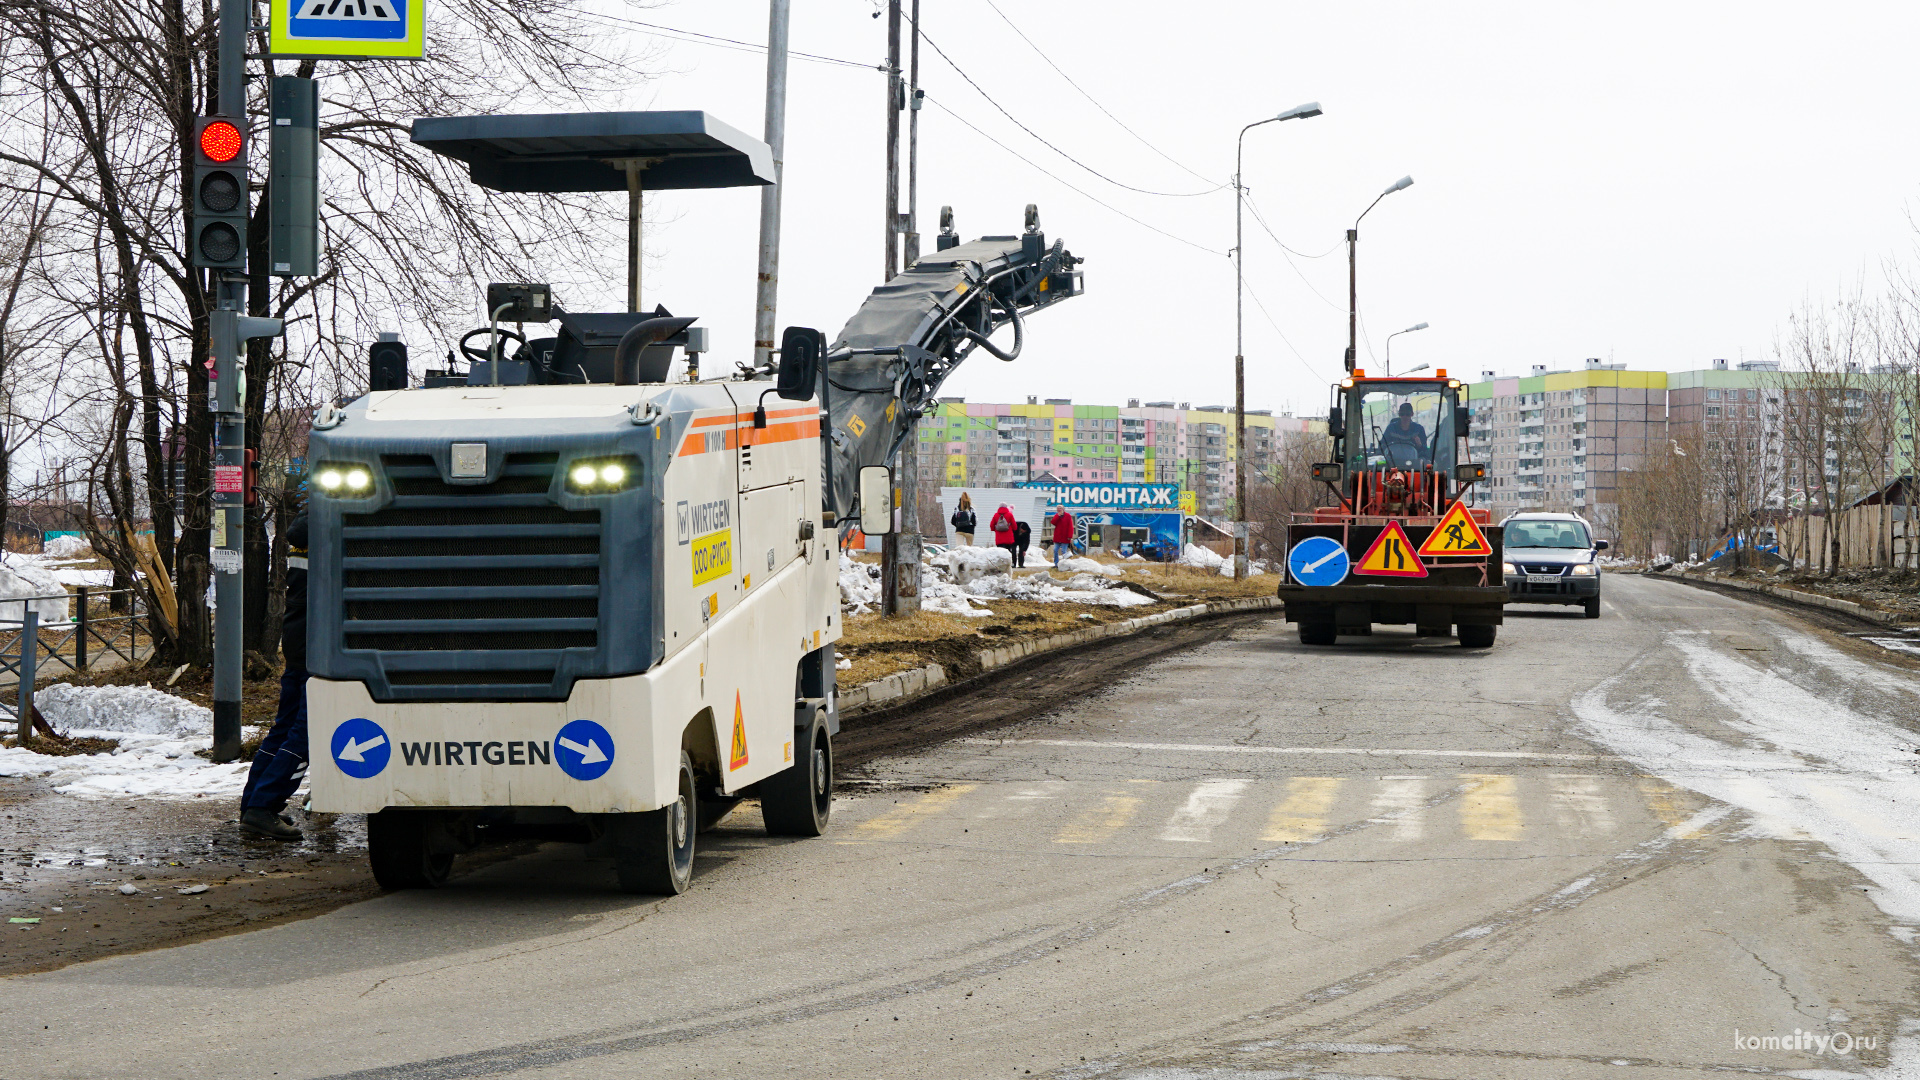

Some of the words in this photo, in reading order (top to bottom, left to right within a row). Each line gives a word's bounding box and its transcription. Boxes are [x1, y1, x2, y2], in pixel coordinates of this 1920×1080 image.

[711, 430, 721, 452] 100
[722, 430, 726, 451] H
[1023, 486, 1172, 505] НОМОНТАЖ
[691, 499, 730, 535] WIRTGEN
[694, 547, 708, 575] ООО
[709, 540, 731, 569] «РУСТ»
[400, 740, 552, 766] WIRTGEN
